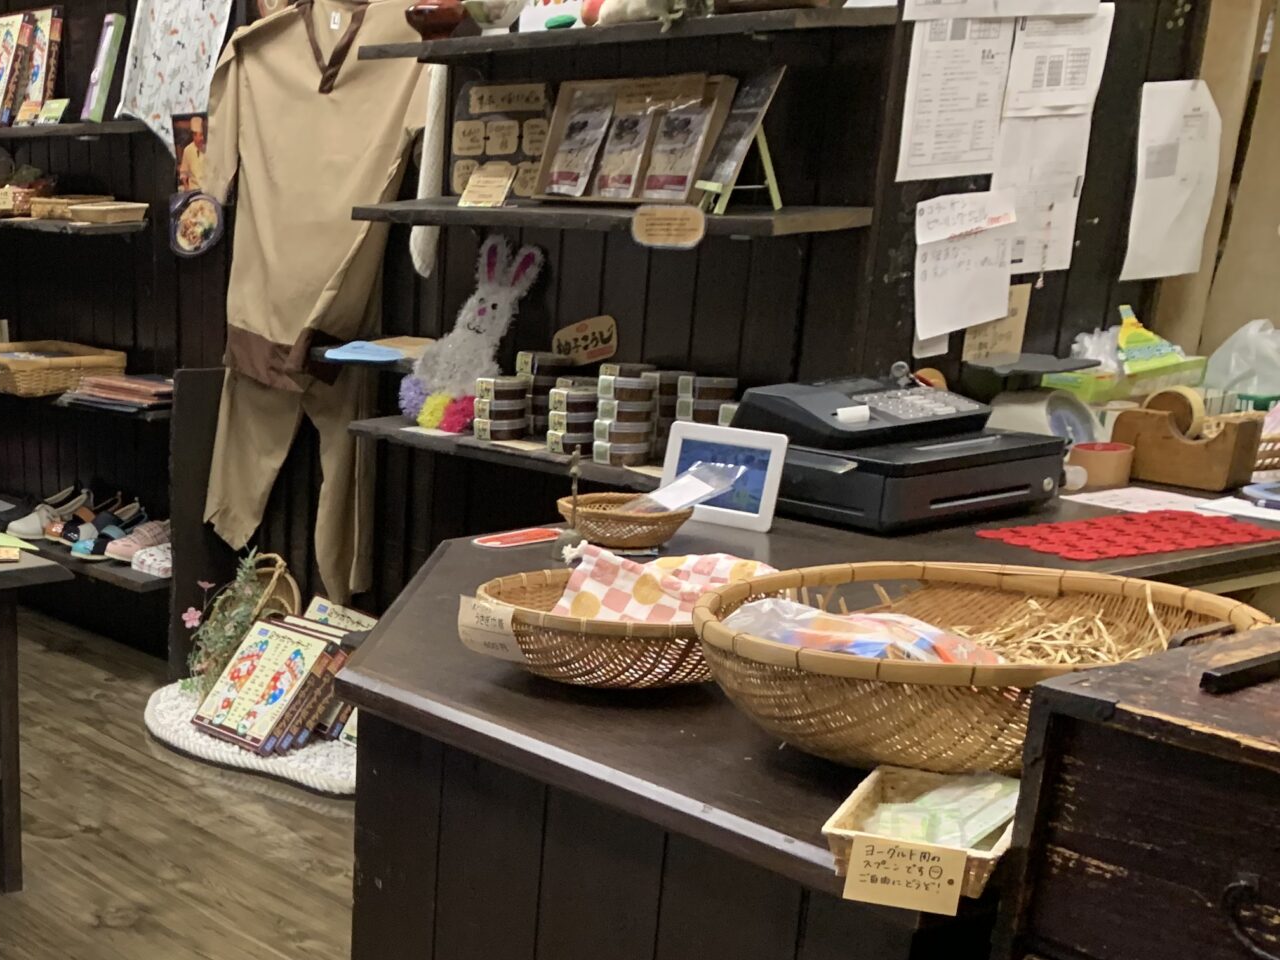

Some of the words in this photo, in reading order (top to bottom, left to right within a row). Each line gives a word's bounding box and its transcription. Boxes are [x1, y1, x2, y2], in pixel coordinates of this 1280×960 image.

[865, 844, 941, 863] ヨーグルト用の
